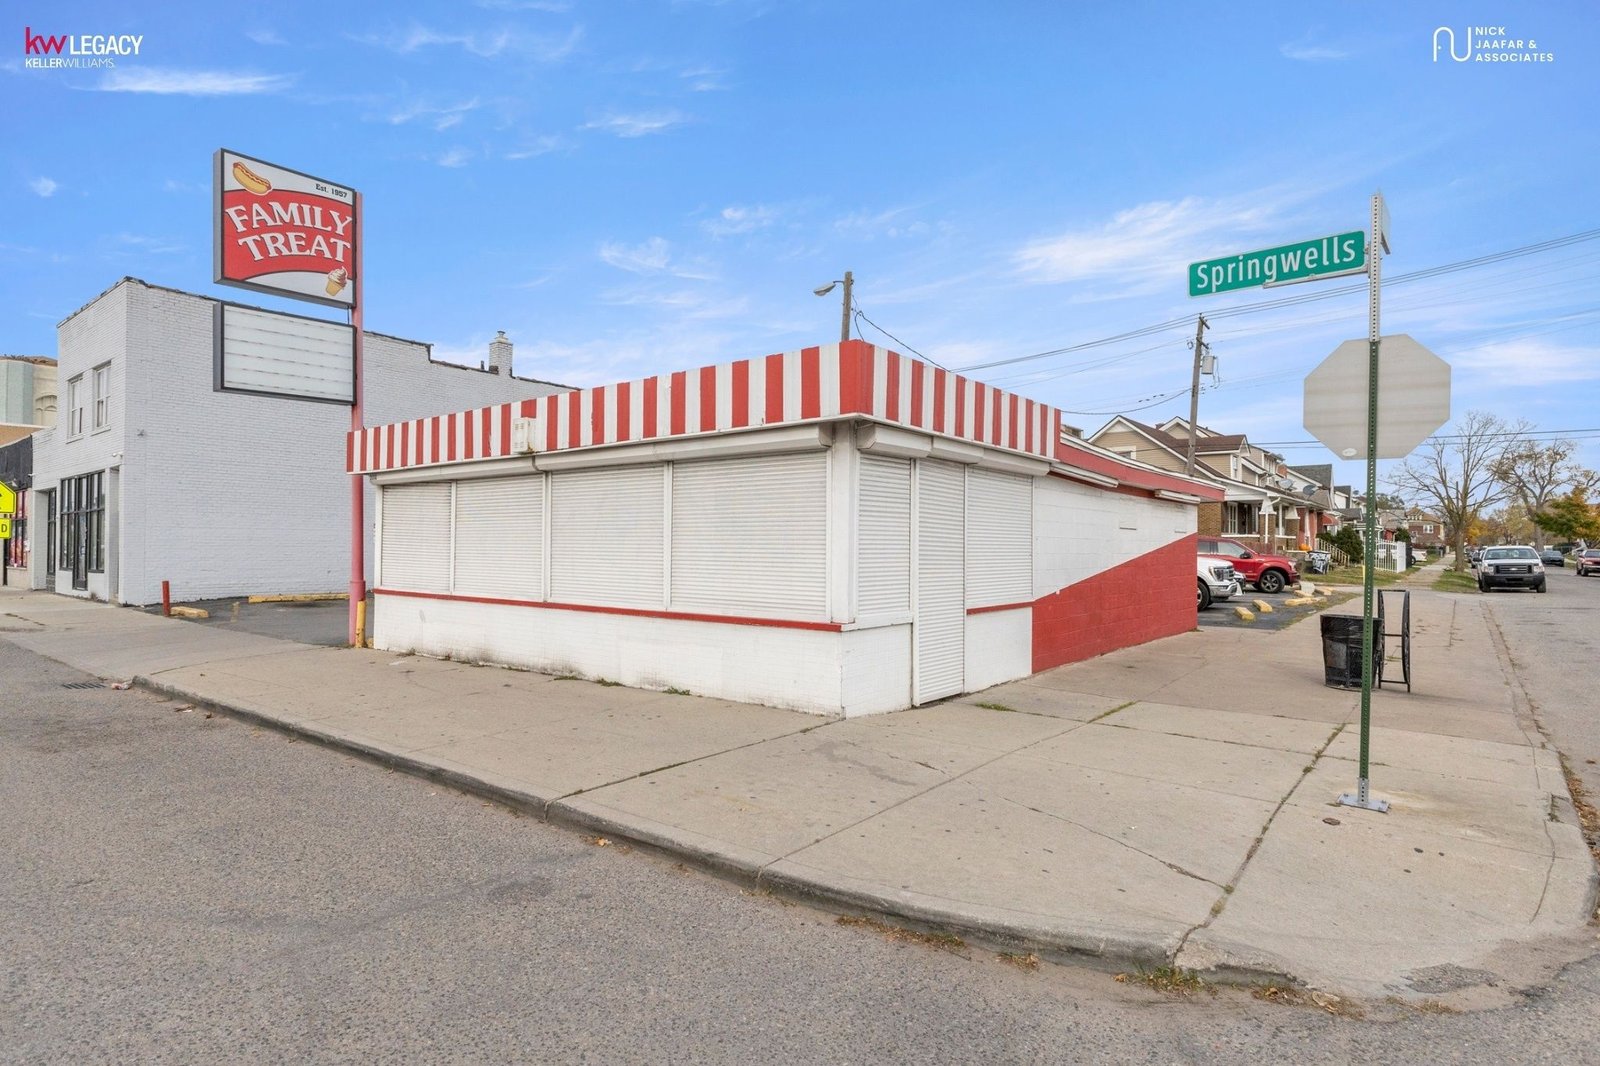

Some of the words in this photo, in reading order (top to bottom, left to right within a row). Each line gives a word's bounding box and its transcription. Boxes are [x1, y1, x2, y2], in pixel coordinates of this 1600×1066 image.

[315, 183, 329, 193] Est.
[331, 188, 348, 198] 1957
[225, 201, 353, 236] FAMILY
[237, 231, 351, 262] TREAT
[1197, 237, 1356, 293] Springwells
